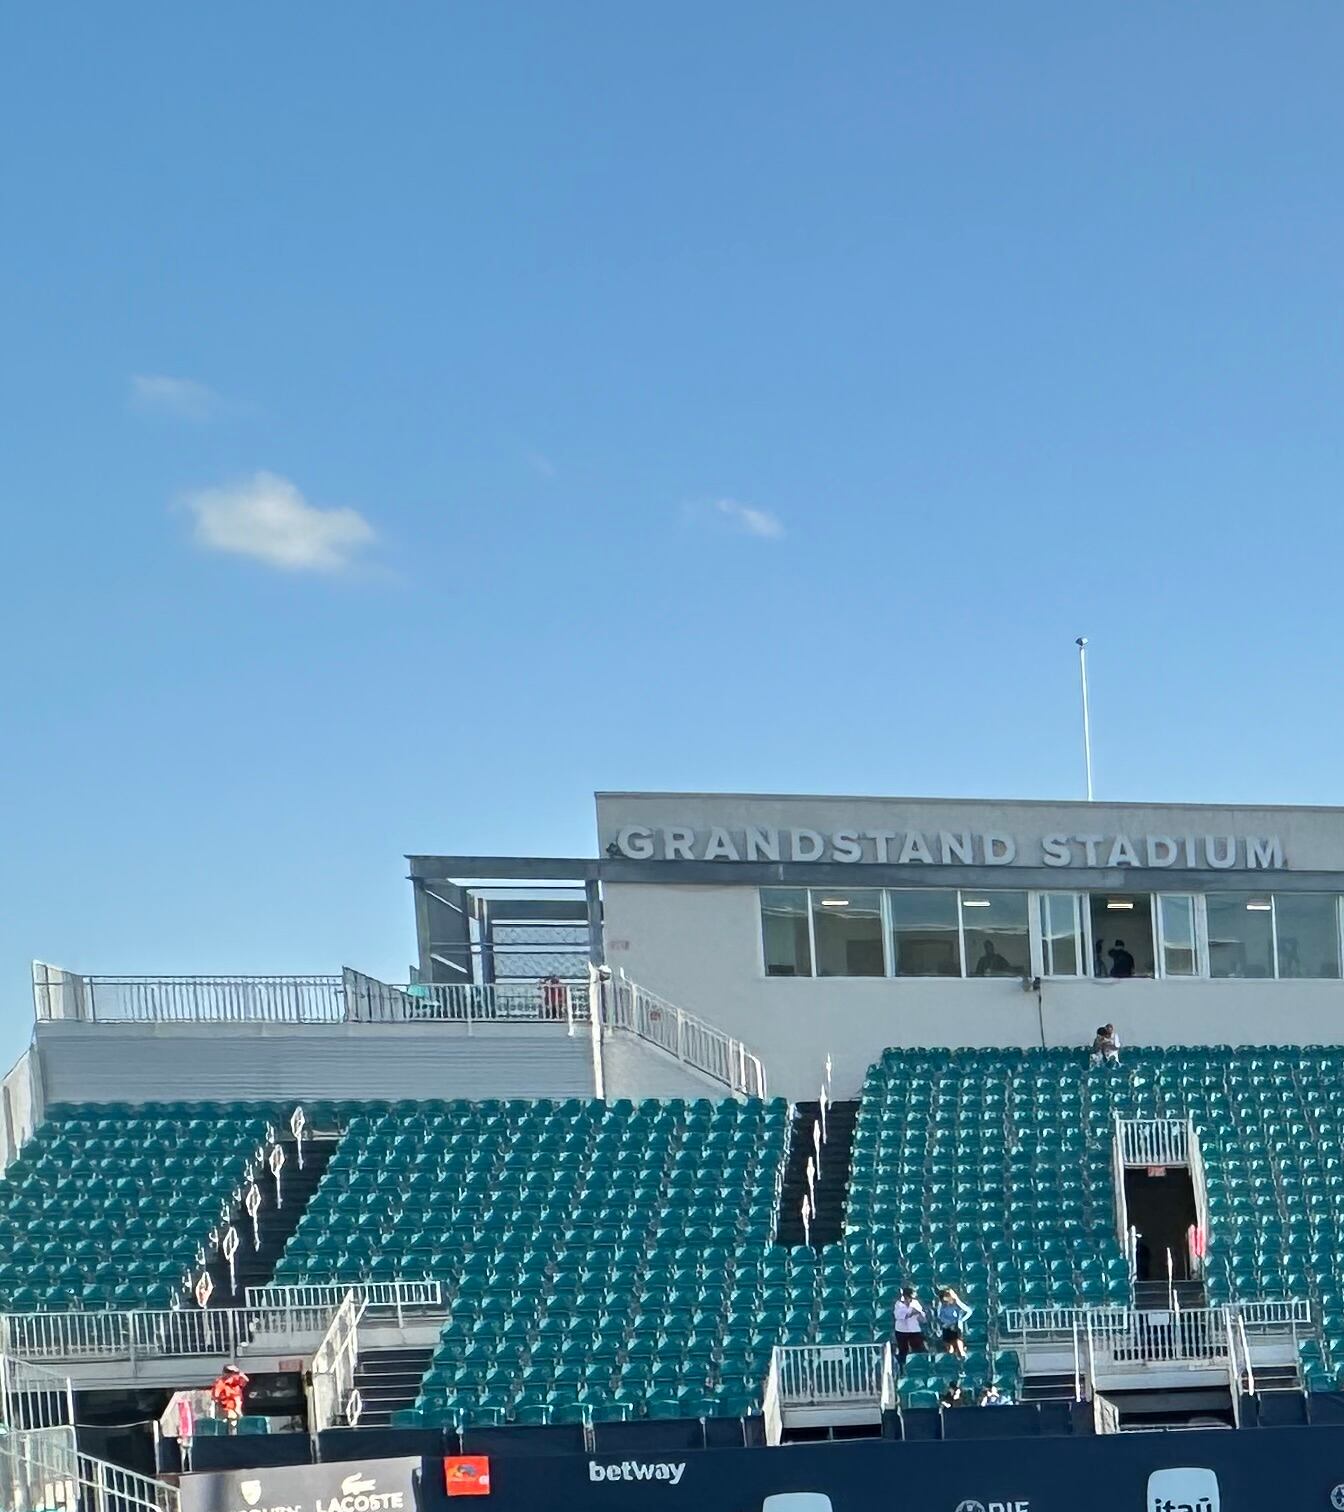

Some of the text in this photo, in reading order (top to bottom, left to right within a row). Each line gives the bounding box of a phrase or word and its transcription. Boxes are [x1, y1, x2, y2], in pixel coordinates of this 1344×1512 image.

[617, 824, 1286, 870] GRANDSTAND STADIUM
[588, 1460, 687, 1484] betway
